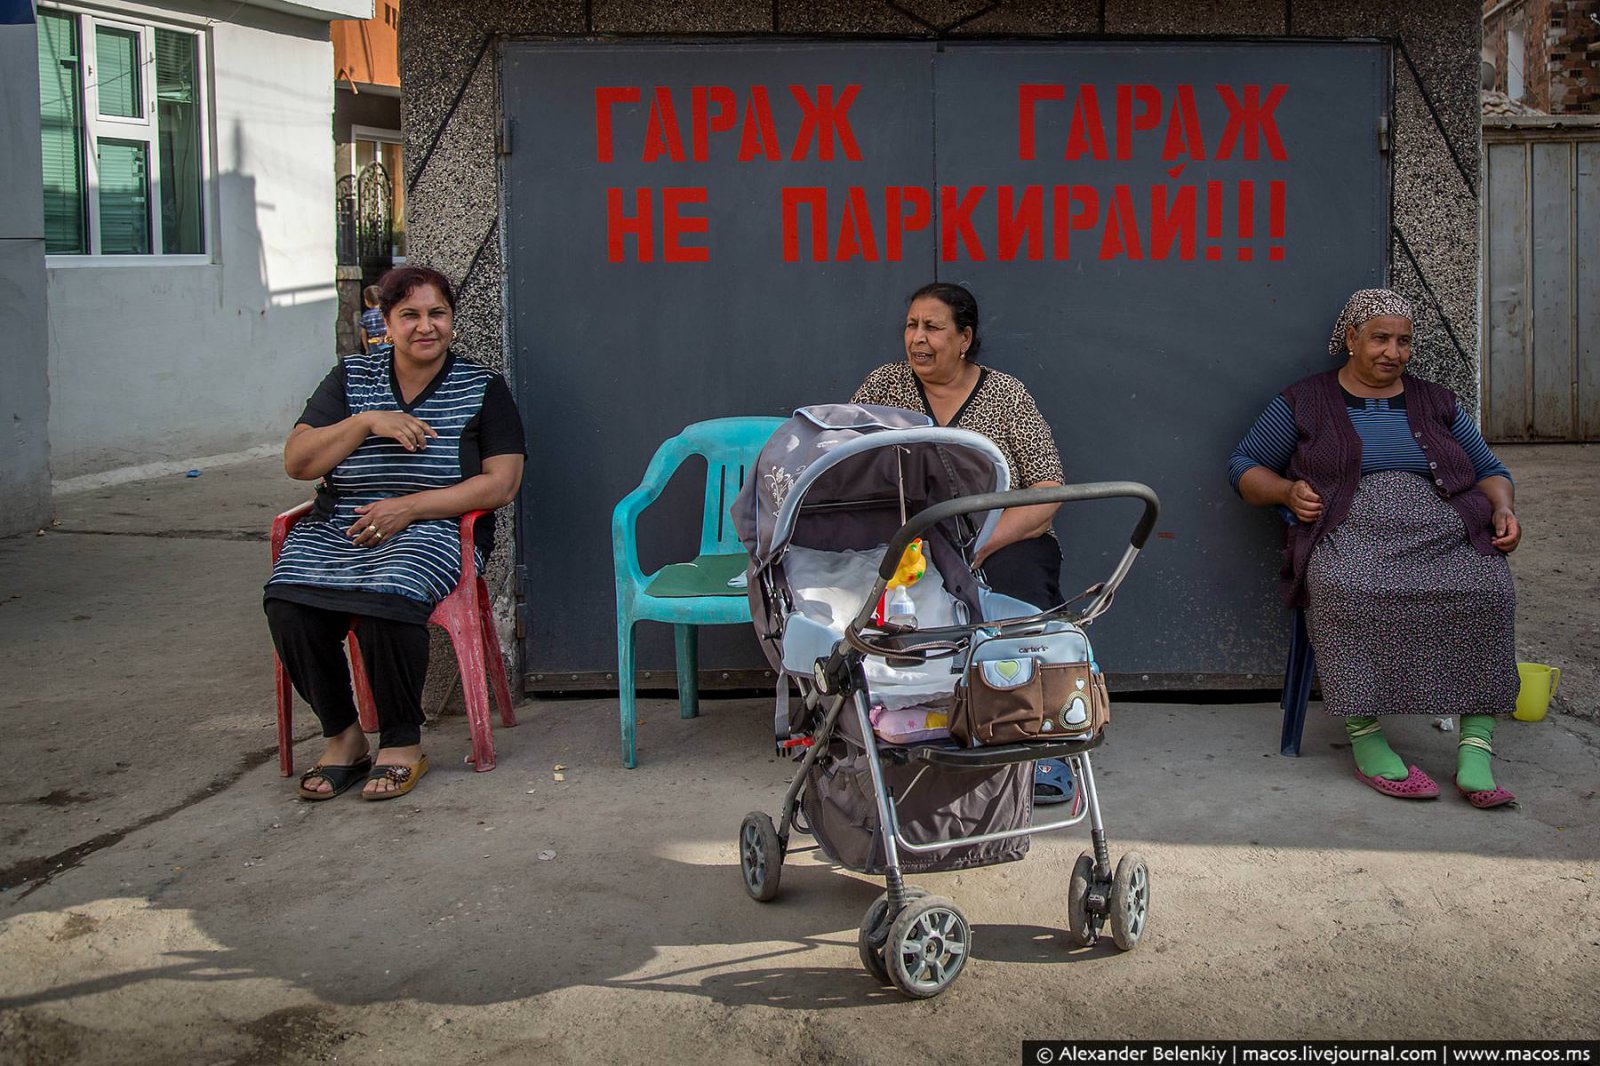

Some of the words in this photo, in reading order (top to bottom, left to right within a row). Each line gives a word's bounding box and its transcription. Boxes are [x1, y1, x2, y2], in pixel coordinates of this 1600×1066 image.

[594, 84, 864, 164] ГАРАЖ
[1018, 83, 1289, 162] ГАРАЖ
[606, 186, 710, 264] НЕ
[780, 163, 1287, 263] ПАРКИРАЙ!!!
[1018, 645, 1047, 654] carter's
